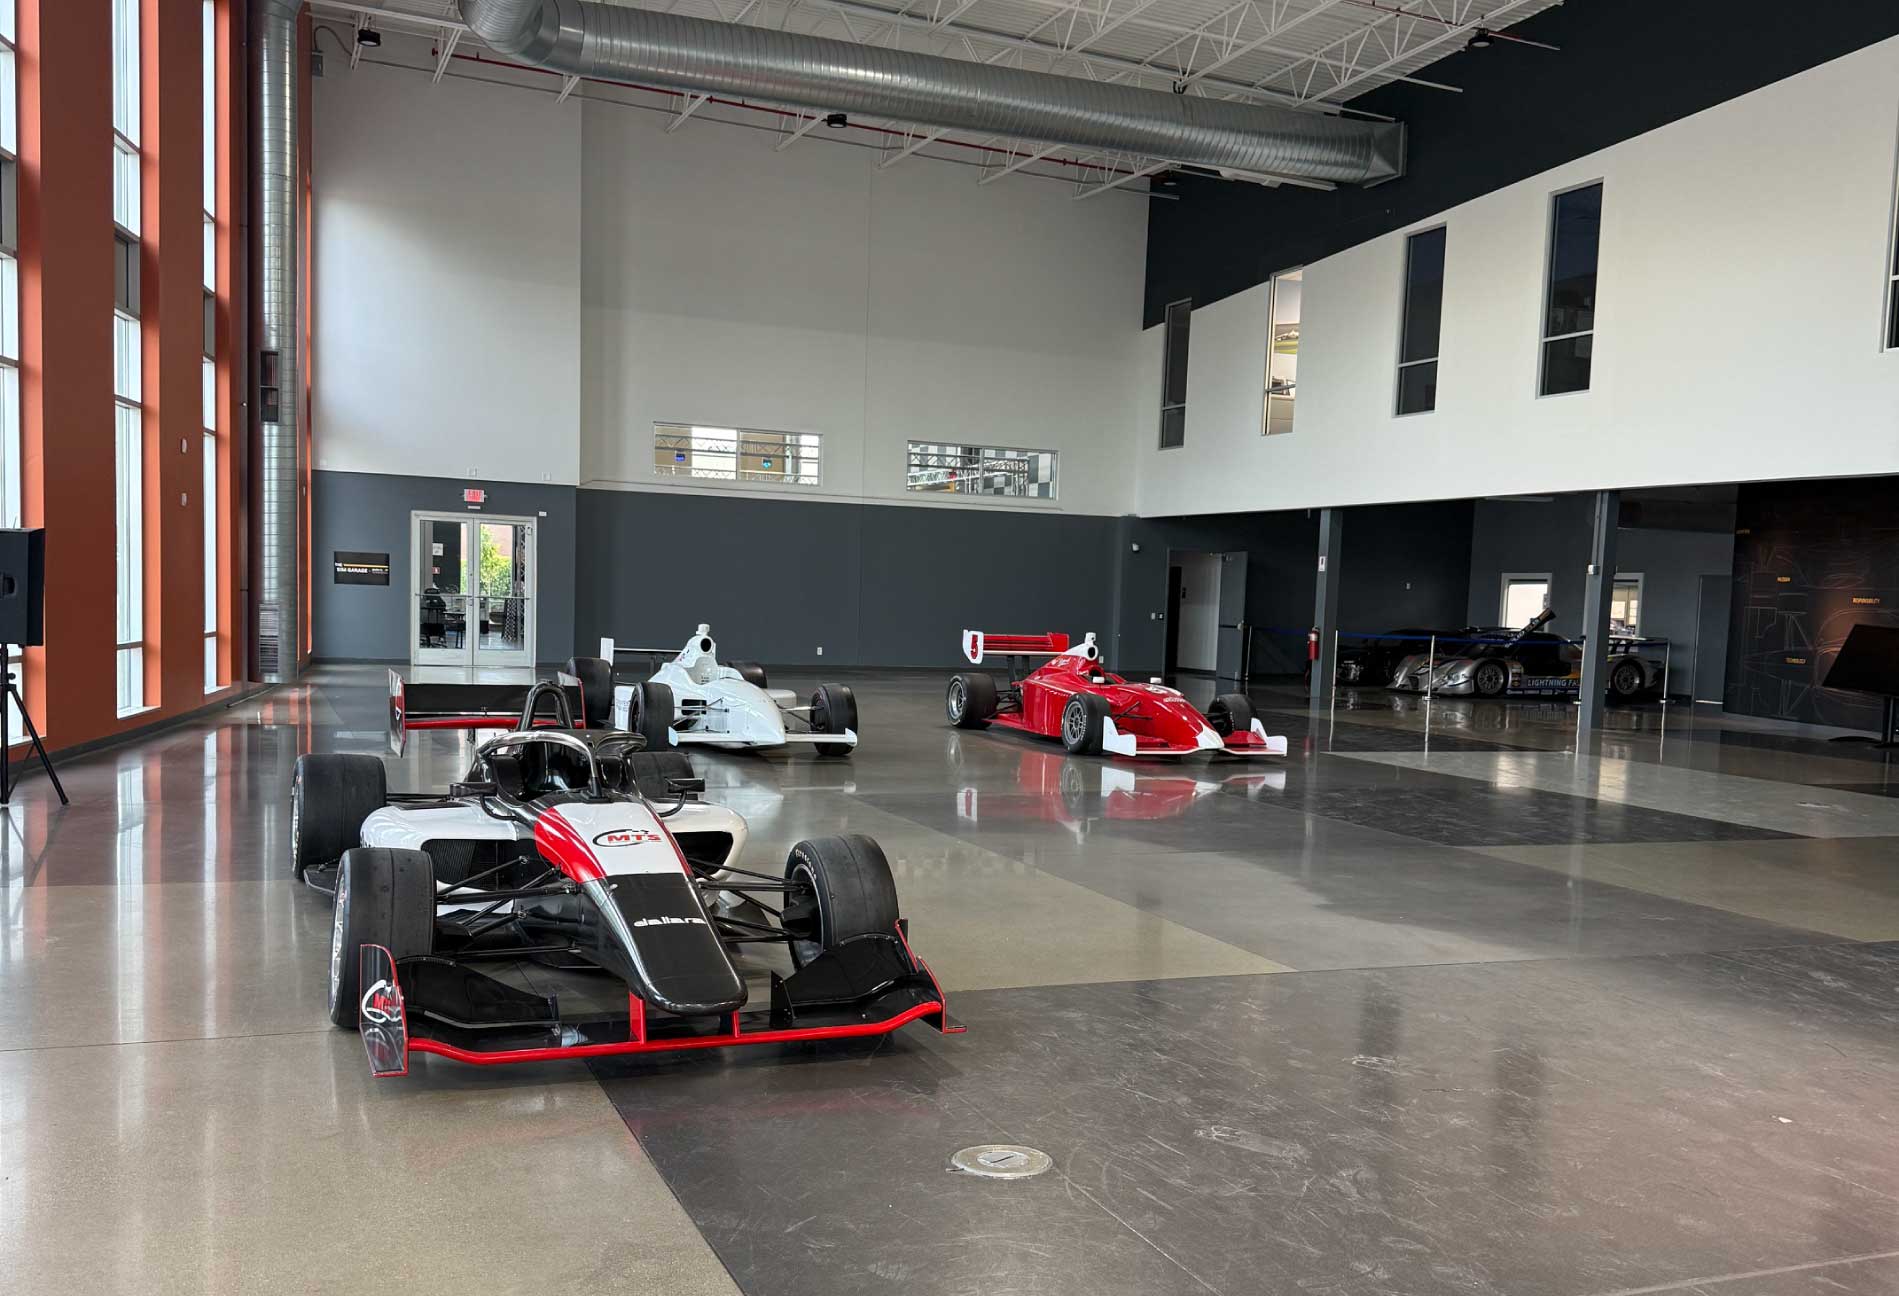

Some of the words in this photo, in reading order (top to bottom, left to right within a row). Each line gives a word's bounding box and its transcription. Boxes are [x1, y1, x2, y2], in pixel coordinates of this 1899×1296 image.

[970, 633, 979, 660] 5
[1527, 679, 1567, 687] LIGHTNING
[607, 834, 661, 842] MTS
[633, 916, 706, 927] dallara
